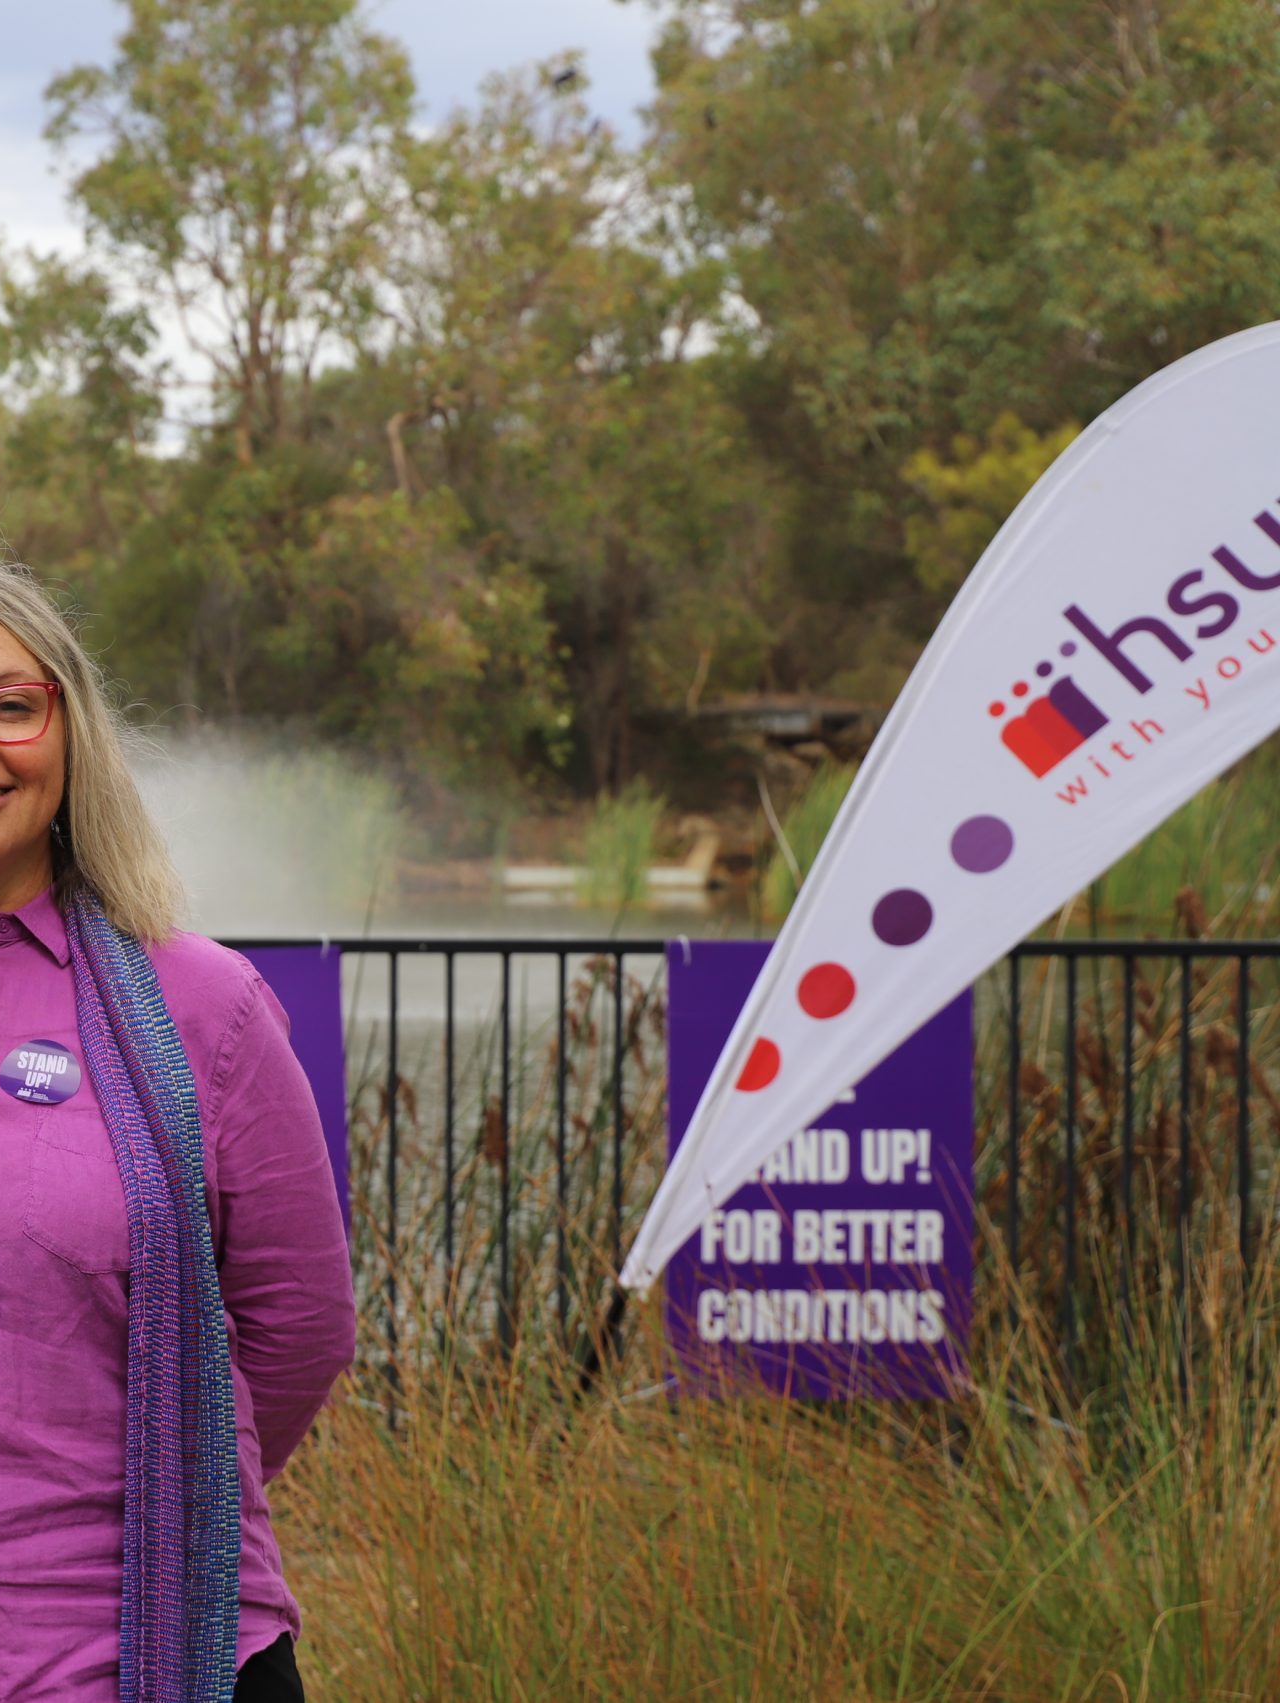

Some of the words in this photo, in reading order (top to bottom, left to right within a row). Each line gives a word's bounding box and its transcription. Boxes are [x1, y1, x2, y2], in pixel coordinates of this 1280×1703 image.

[1063, 497, 1280, 695] hsu
[1055, 718, 1165, 806] with
[1184, 628, 1277, 711] you
[17, 1050, 68, 1075] STAND
[25, 1070, 53, 1090] UP!
[742, 1128, 851, 1185] AND
[860, 1128, 932, 1185] UP!
[700, 1208, 782, 1264] FOR
[793, 1208, 945, 1265] BETTER
[697, 1287, 946, 1344] CONDITIONS
